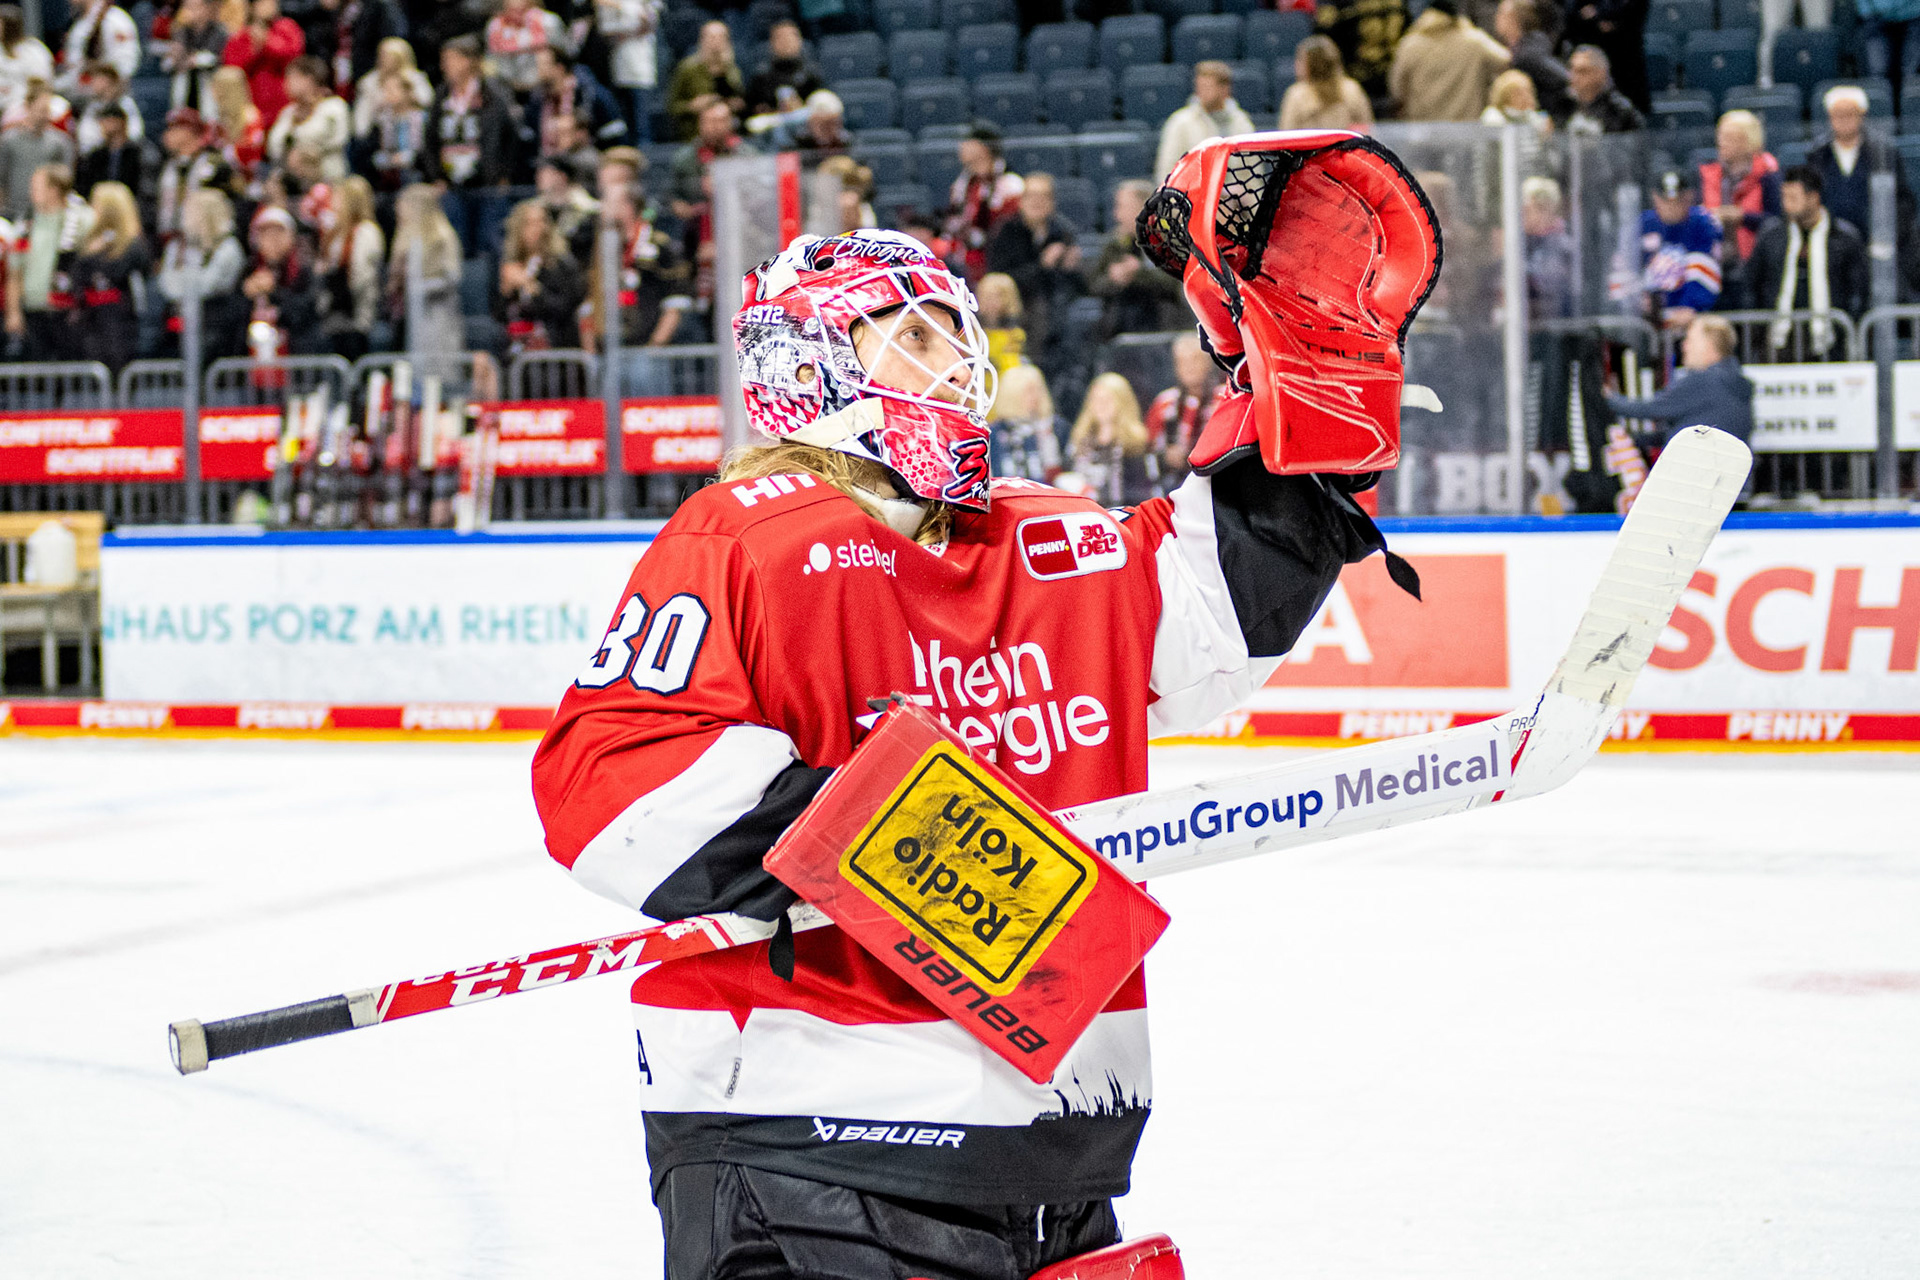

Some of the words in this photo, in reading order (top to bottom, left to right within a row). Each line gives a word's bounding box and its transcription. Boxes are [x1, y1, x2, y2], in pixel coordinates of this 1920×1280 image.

[745, 304, 785, 325] 1972
[1299, 340, 1385, 363] TRUE
[248, 603, 357, 644] PORZ
[374, 604, 445, 645] AM
[460, 604, 588, 644] RHEIN
[574, 592, 712, 697] 30
[1646, 566, 1920, 672] SCH
[911, 693, 1110, 775] ergie
[941, 794, 1038, 889] Köln
[1095, 788, 1325, 864] mpuGroup
[1335, 739, 1499, 811] Medical
[893, 836, 1012, 947] Radio
[449, 938, 647, 1007] CCM
[893, 933, 1050, 1054] BAUER
[837, 1125, 966, 1149] BAUER
